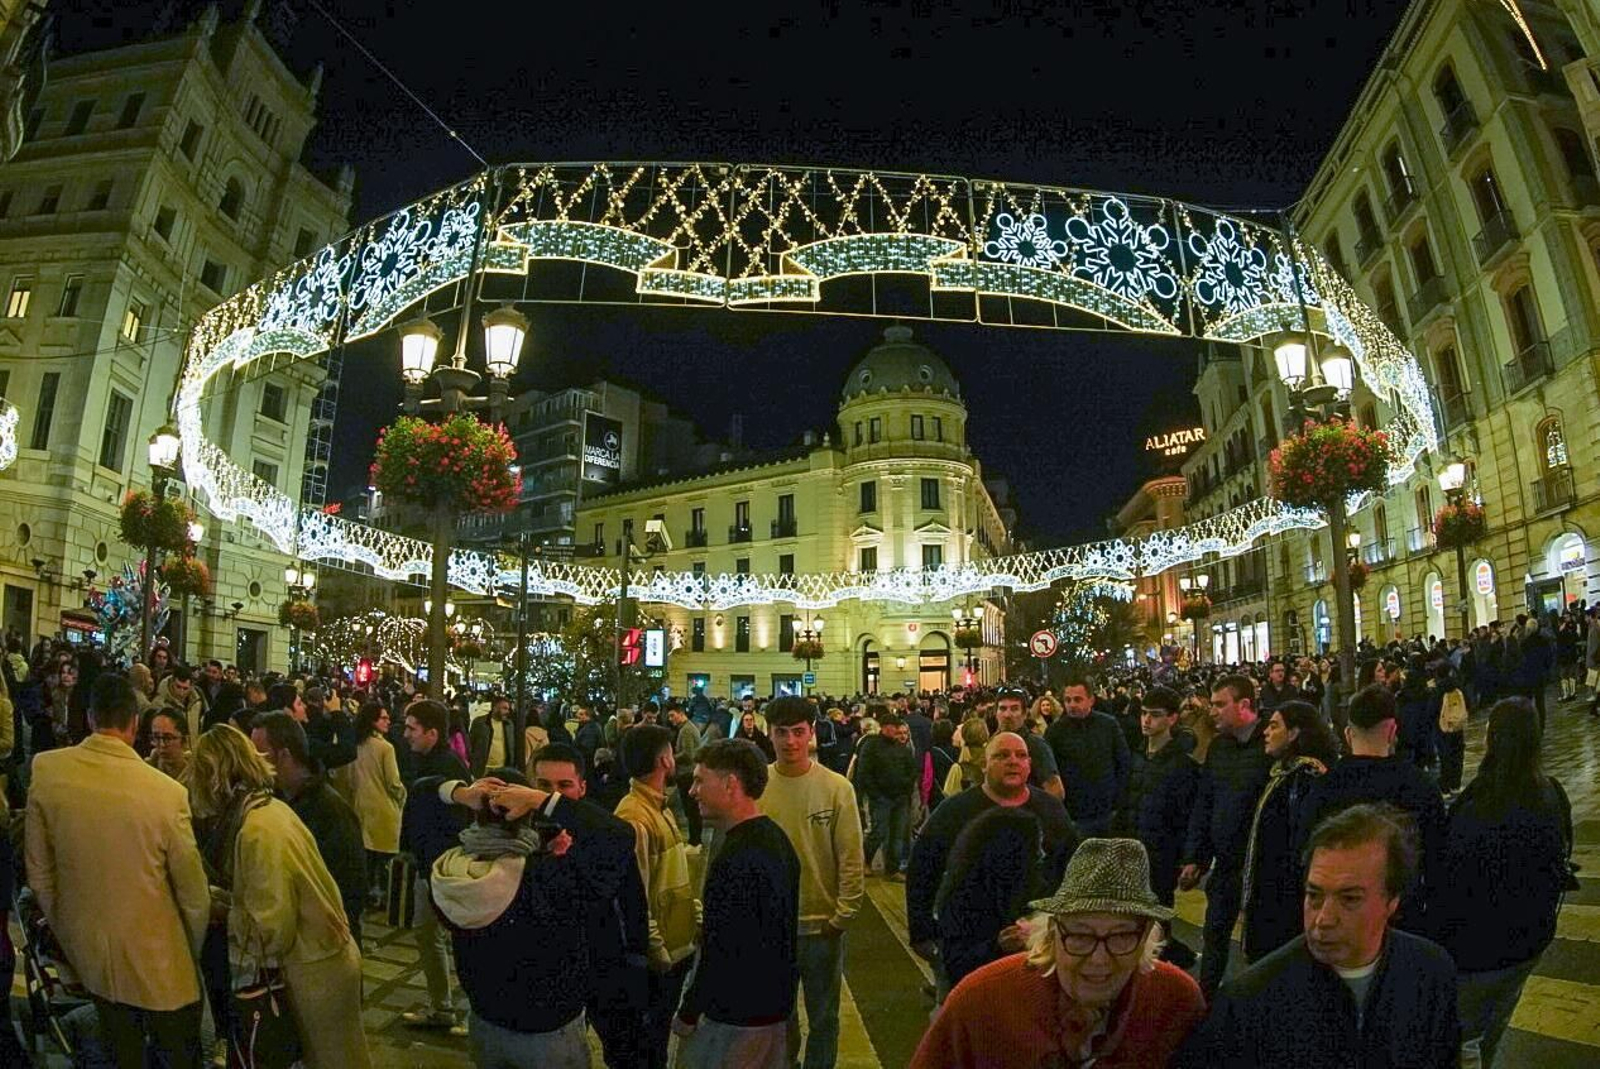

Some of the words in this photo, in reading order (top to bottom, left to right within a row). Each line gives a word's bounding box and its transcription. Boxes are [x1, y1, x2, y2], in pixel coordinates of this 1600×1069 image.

[1145, 427, 1206, 451] ALIATAR
[585, 445, 610, 459] MARCA
[611, 451, 620, 461] LA
[585, 454, 620, 469] DIFERENCIA
